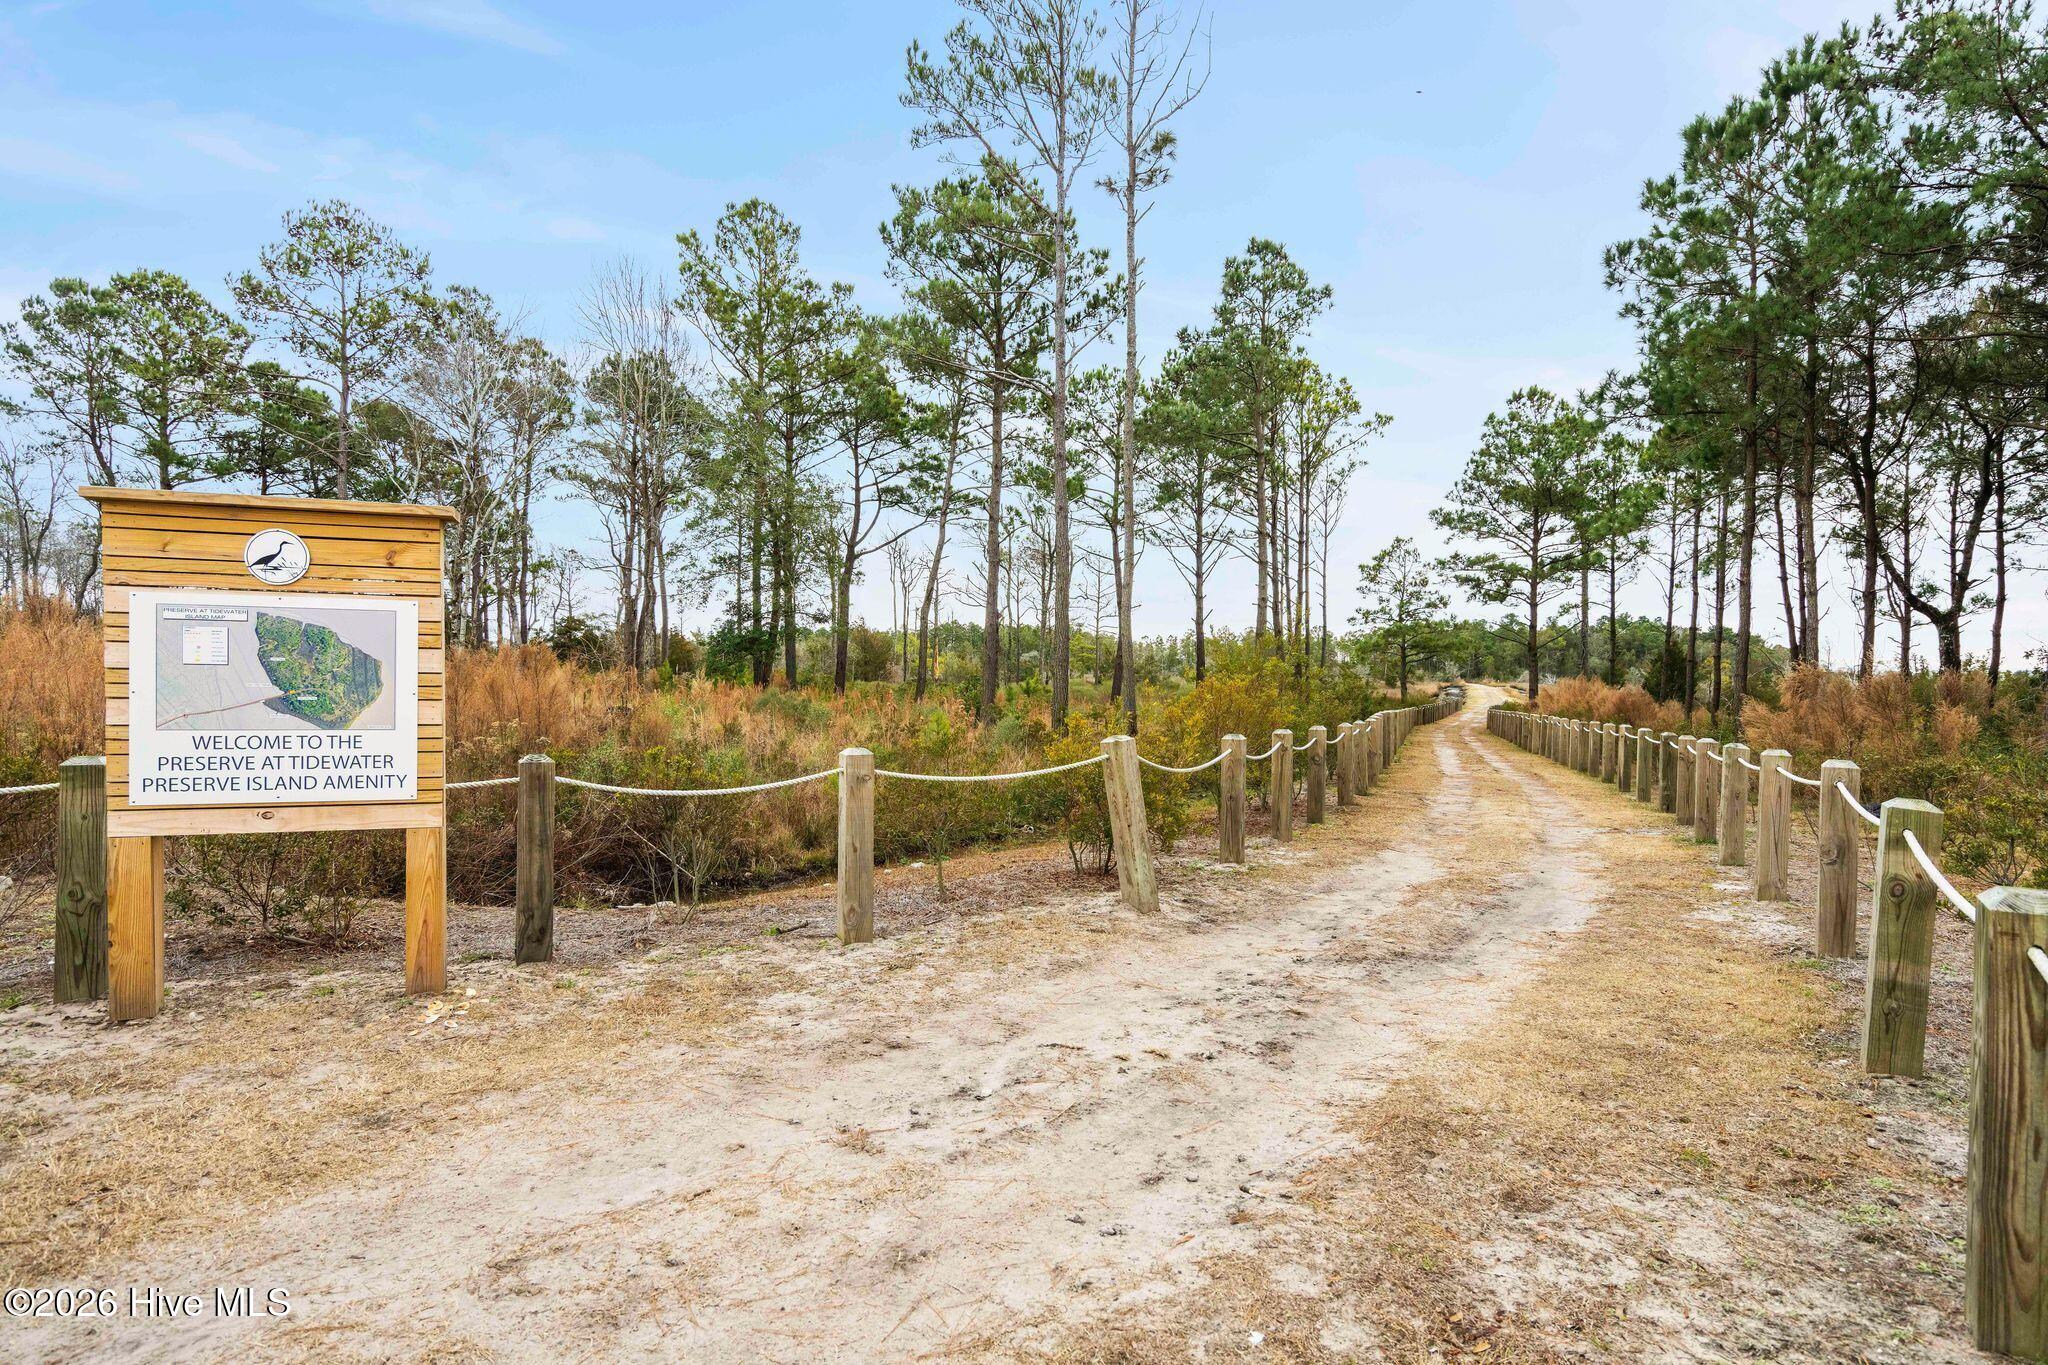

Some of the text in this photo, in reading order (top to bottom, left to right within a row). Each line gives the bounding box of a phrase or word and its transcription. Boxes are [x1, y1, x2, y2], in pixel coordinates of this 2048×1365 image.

[192, 735, 363, 750] WELCOME TO THE
[158, 755, 394, 771] PRESERVE AT TIDEWATER
[142, 775, 408, 793] PRESERVE ISLAND AMENITY
